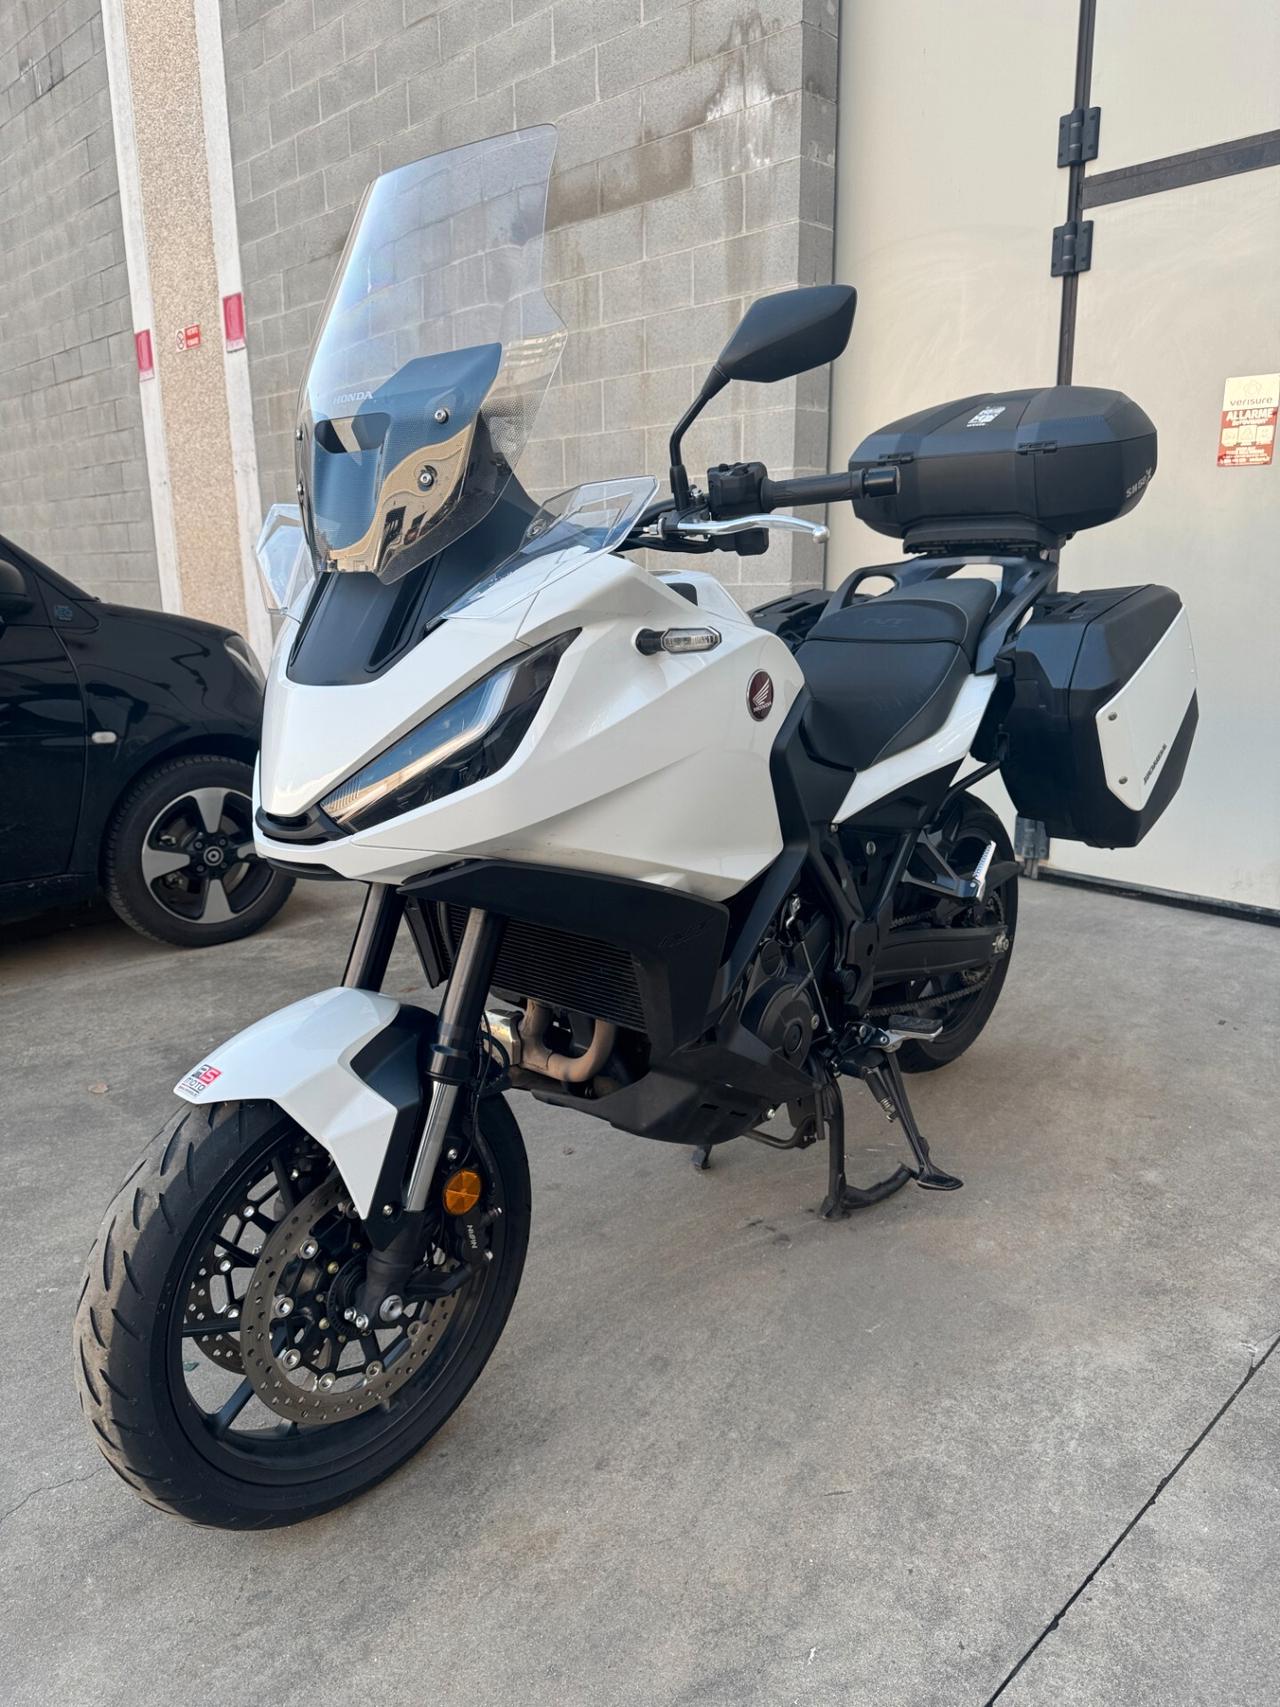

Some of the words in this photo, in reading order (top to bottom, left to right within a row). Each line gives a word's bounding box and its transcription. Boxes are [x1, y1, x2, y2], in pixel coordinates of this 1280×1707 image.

[332, 391, 374, 404] HONDA
[1230, 396, 1273, 407] verisure
[1226, 408, 1274, 421] ALLARME
